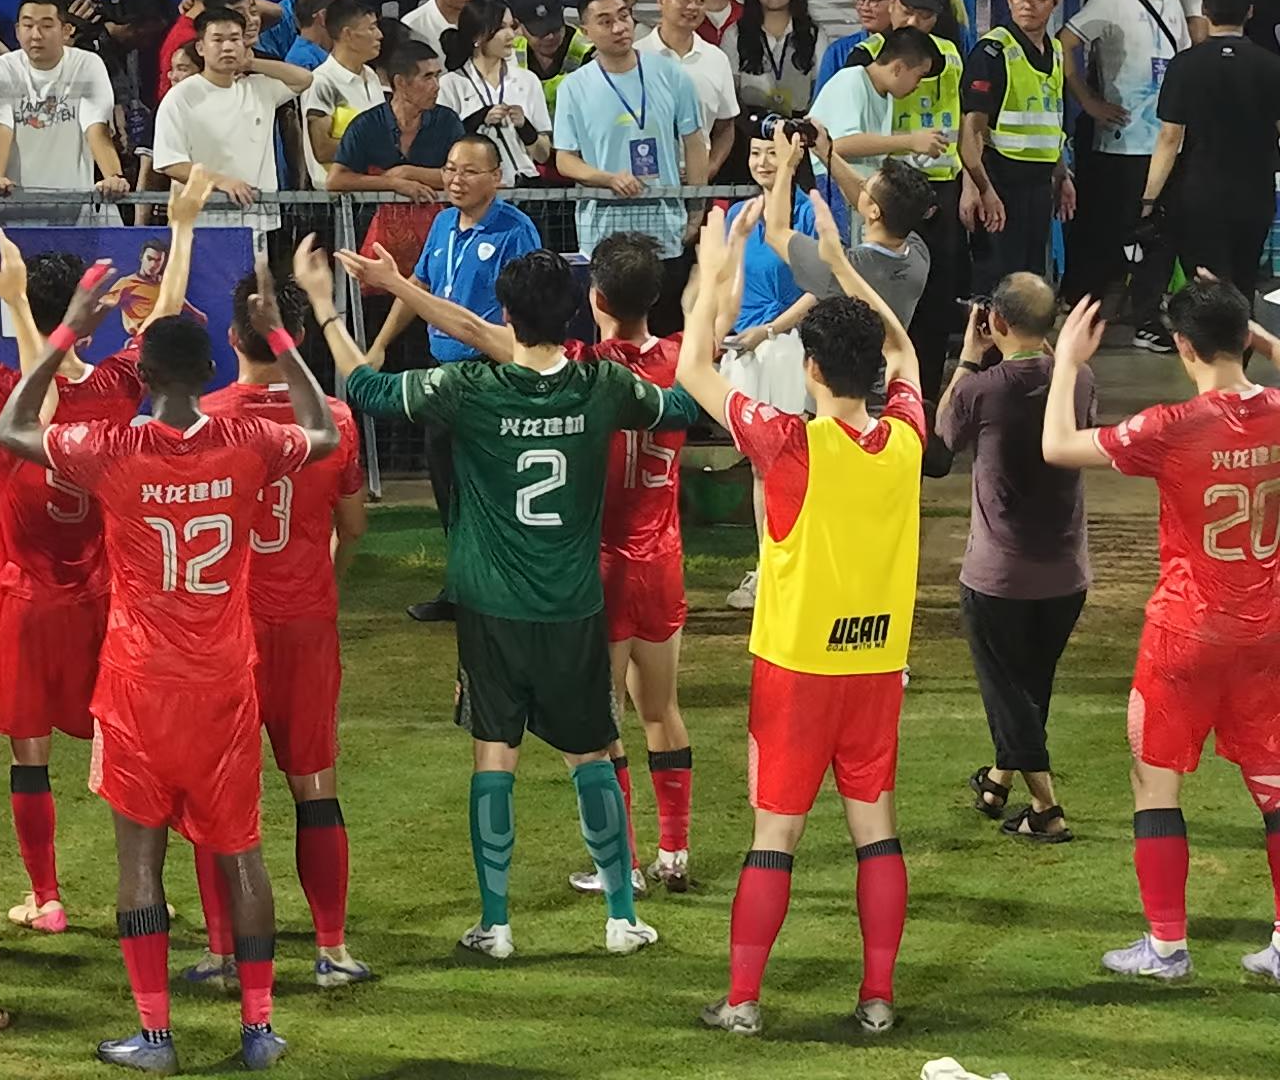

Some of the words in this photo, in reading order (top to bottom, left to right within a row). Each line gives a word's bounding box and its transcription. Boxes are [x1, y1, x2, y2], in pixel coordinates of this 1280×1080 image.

[515, 449, 568, 527] 2
[624, 428, 677, 490] 15
[143, 513, 234, 595] 12
[1202, 477, 1280, 562] 20
[828, 614, 891, 644] UCAN
